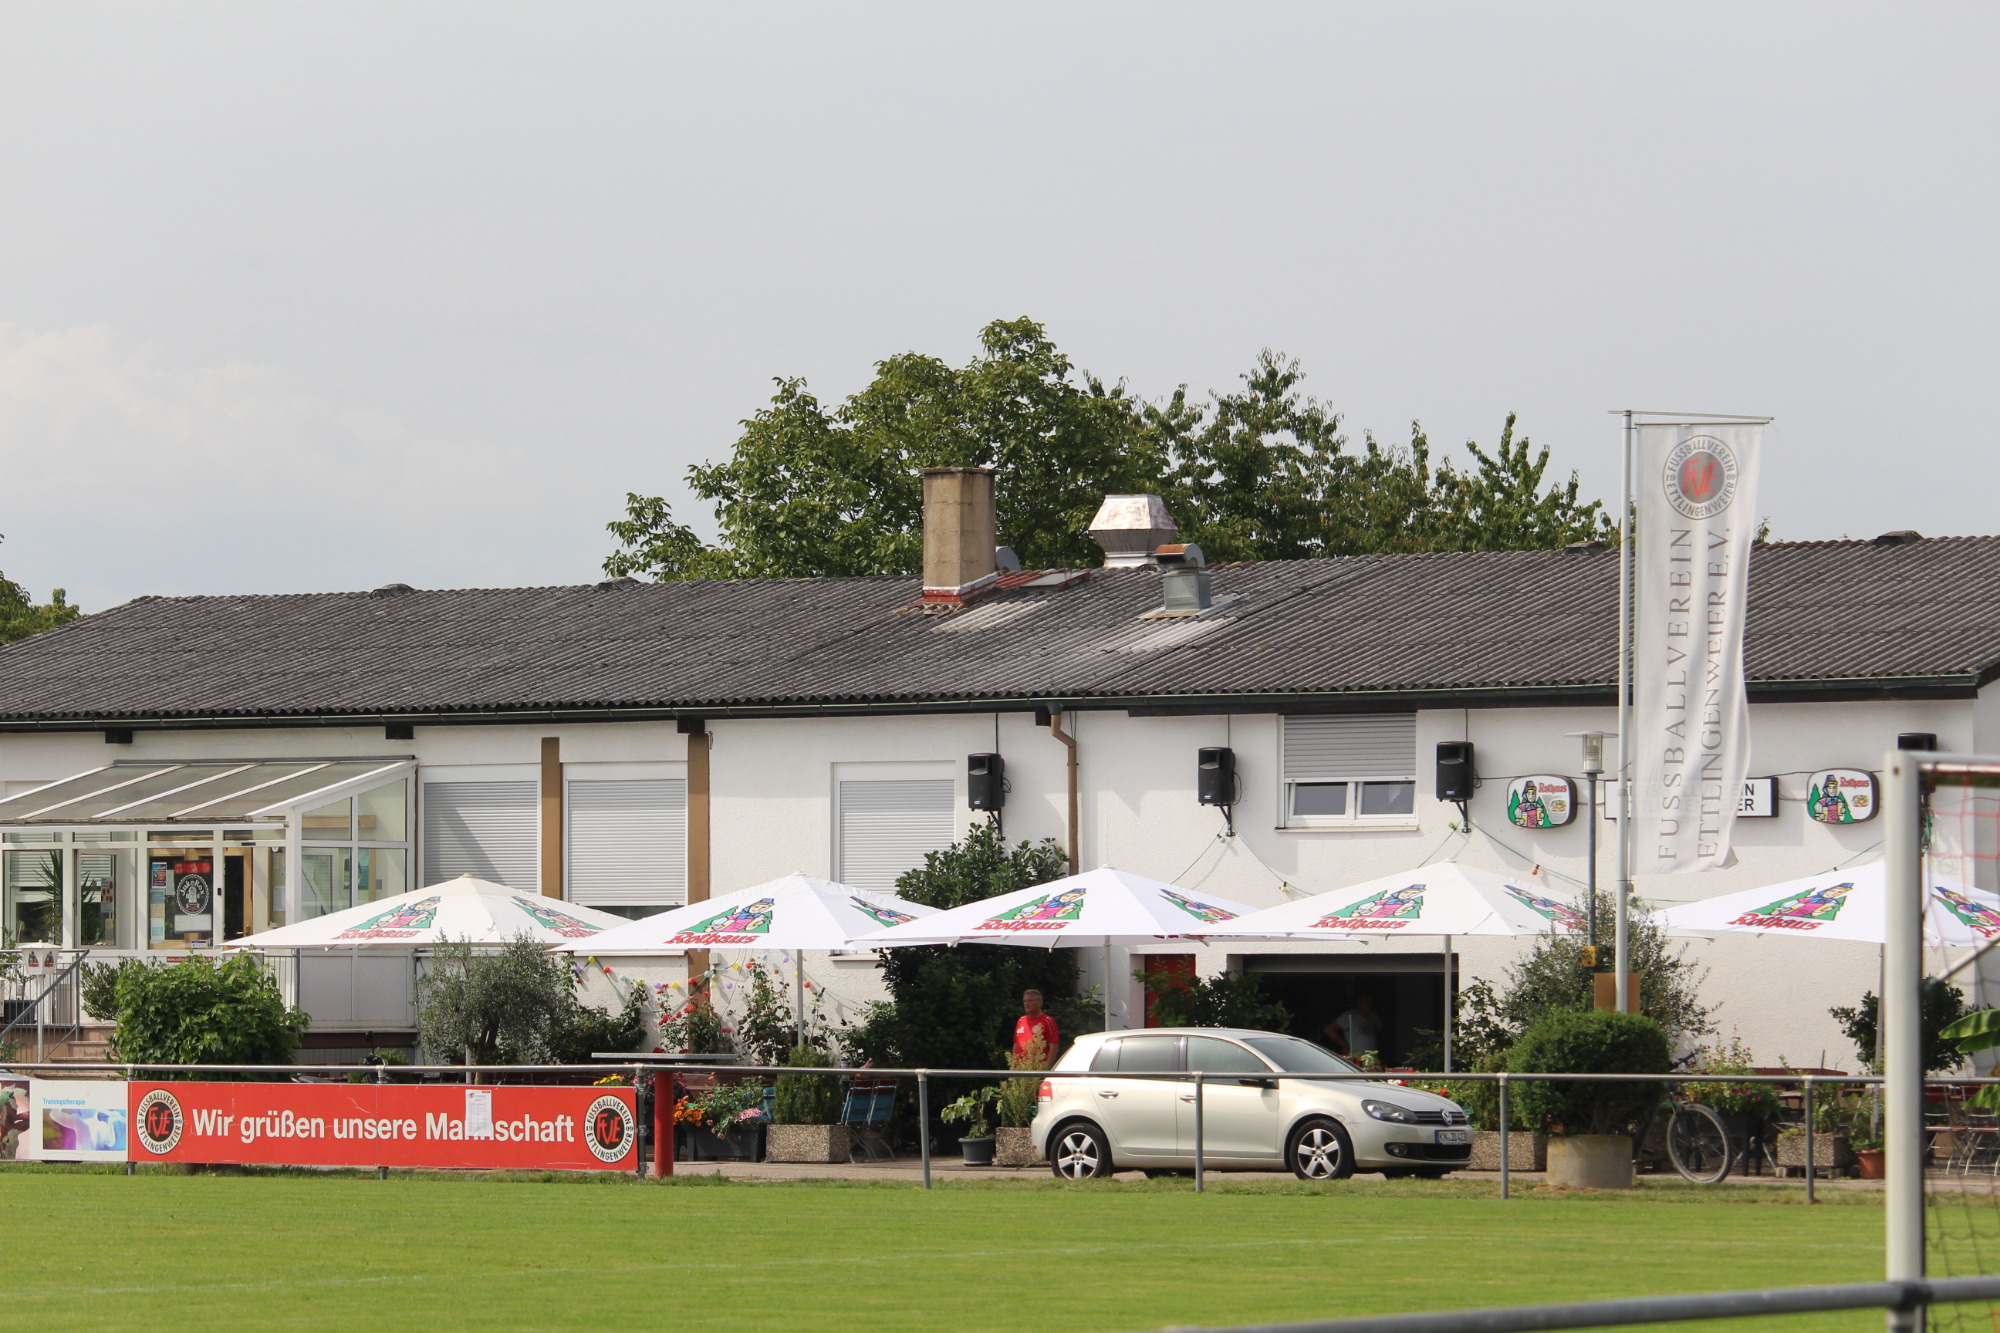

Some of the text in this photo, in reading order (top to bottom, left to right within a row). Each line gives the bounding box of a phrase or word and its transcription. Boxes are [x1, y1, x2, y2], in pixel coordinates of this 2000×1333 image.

[1667, 439, 1735, 473] FUSSBALLVEREIN
[1666, 482, 1735, 517] ETTLINGENWEIER
[1658, 528, 1692, 861] FUSSBALLVEREIN
[1698, 589, 1727, 860] ETTLINGENWEIER
[972, 919, 1070, 932] Rothaus
[1307, 916, 1411, 931] Rothaus
[1726, 913, 1824, 931] Rothaus
[664, 931, 760, 946] Rothaus
[43, 1098, 86, 1106] Trainingstherapie
[139, 1092, 181, 1118] FUSSBALLVEREIN
[587, 1098, 632, 1125] FUSSBALLVEREIN
[139, 1125, 181, 1153] ETTLINGENWEIER
[192, 1109, 234, 1137] Wir
[240, 1110, 325, 1144] grüßen
[333, 1117, 418, 1140] unsere
[425, 1112, 575, 1142] Maschaft
[586, 1132, 633, 1161] ETTLINGENWEIER
